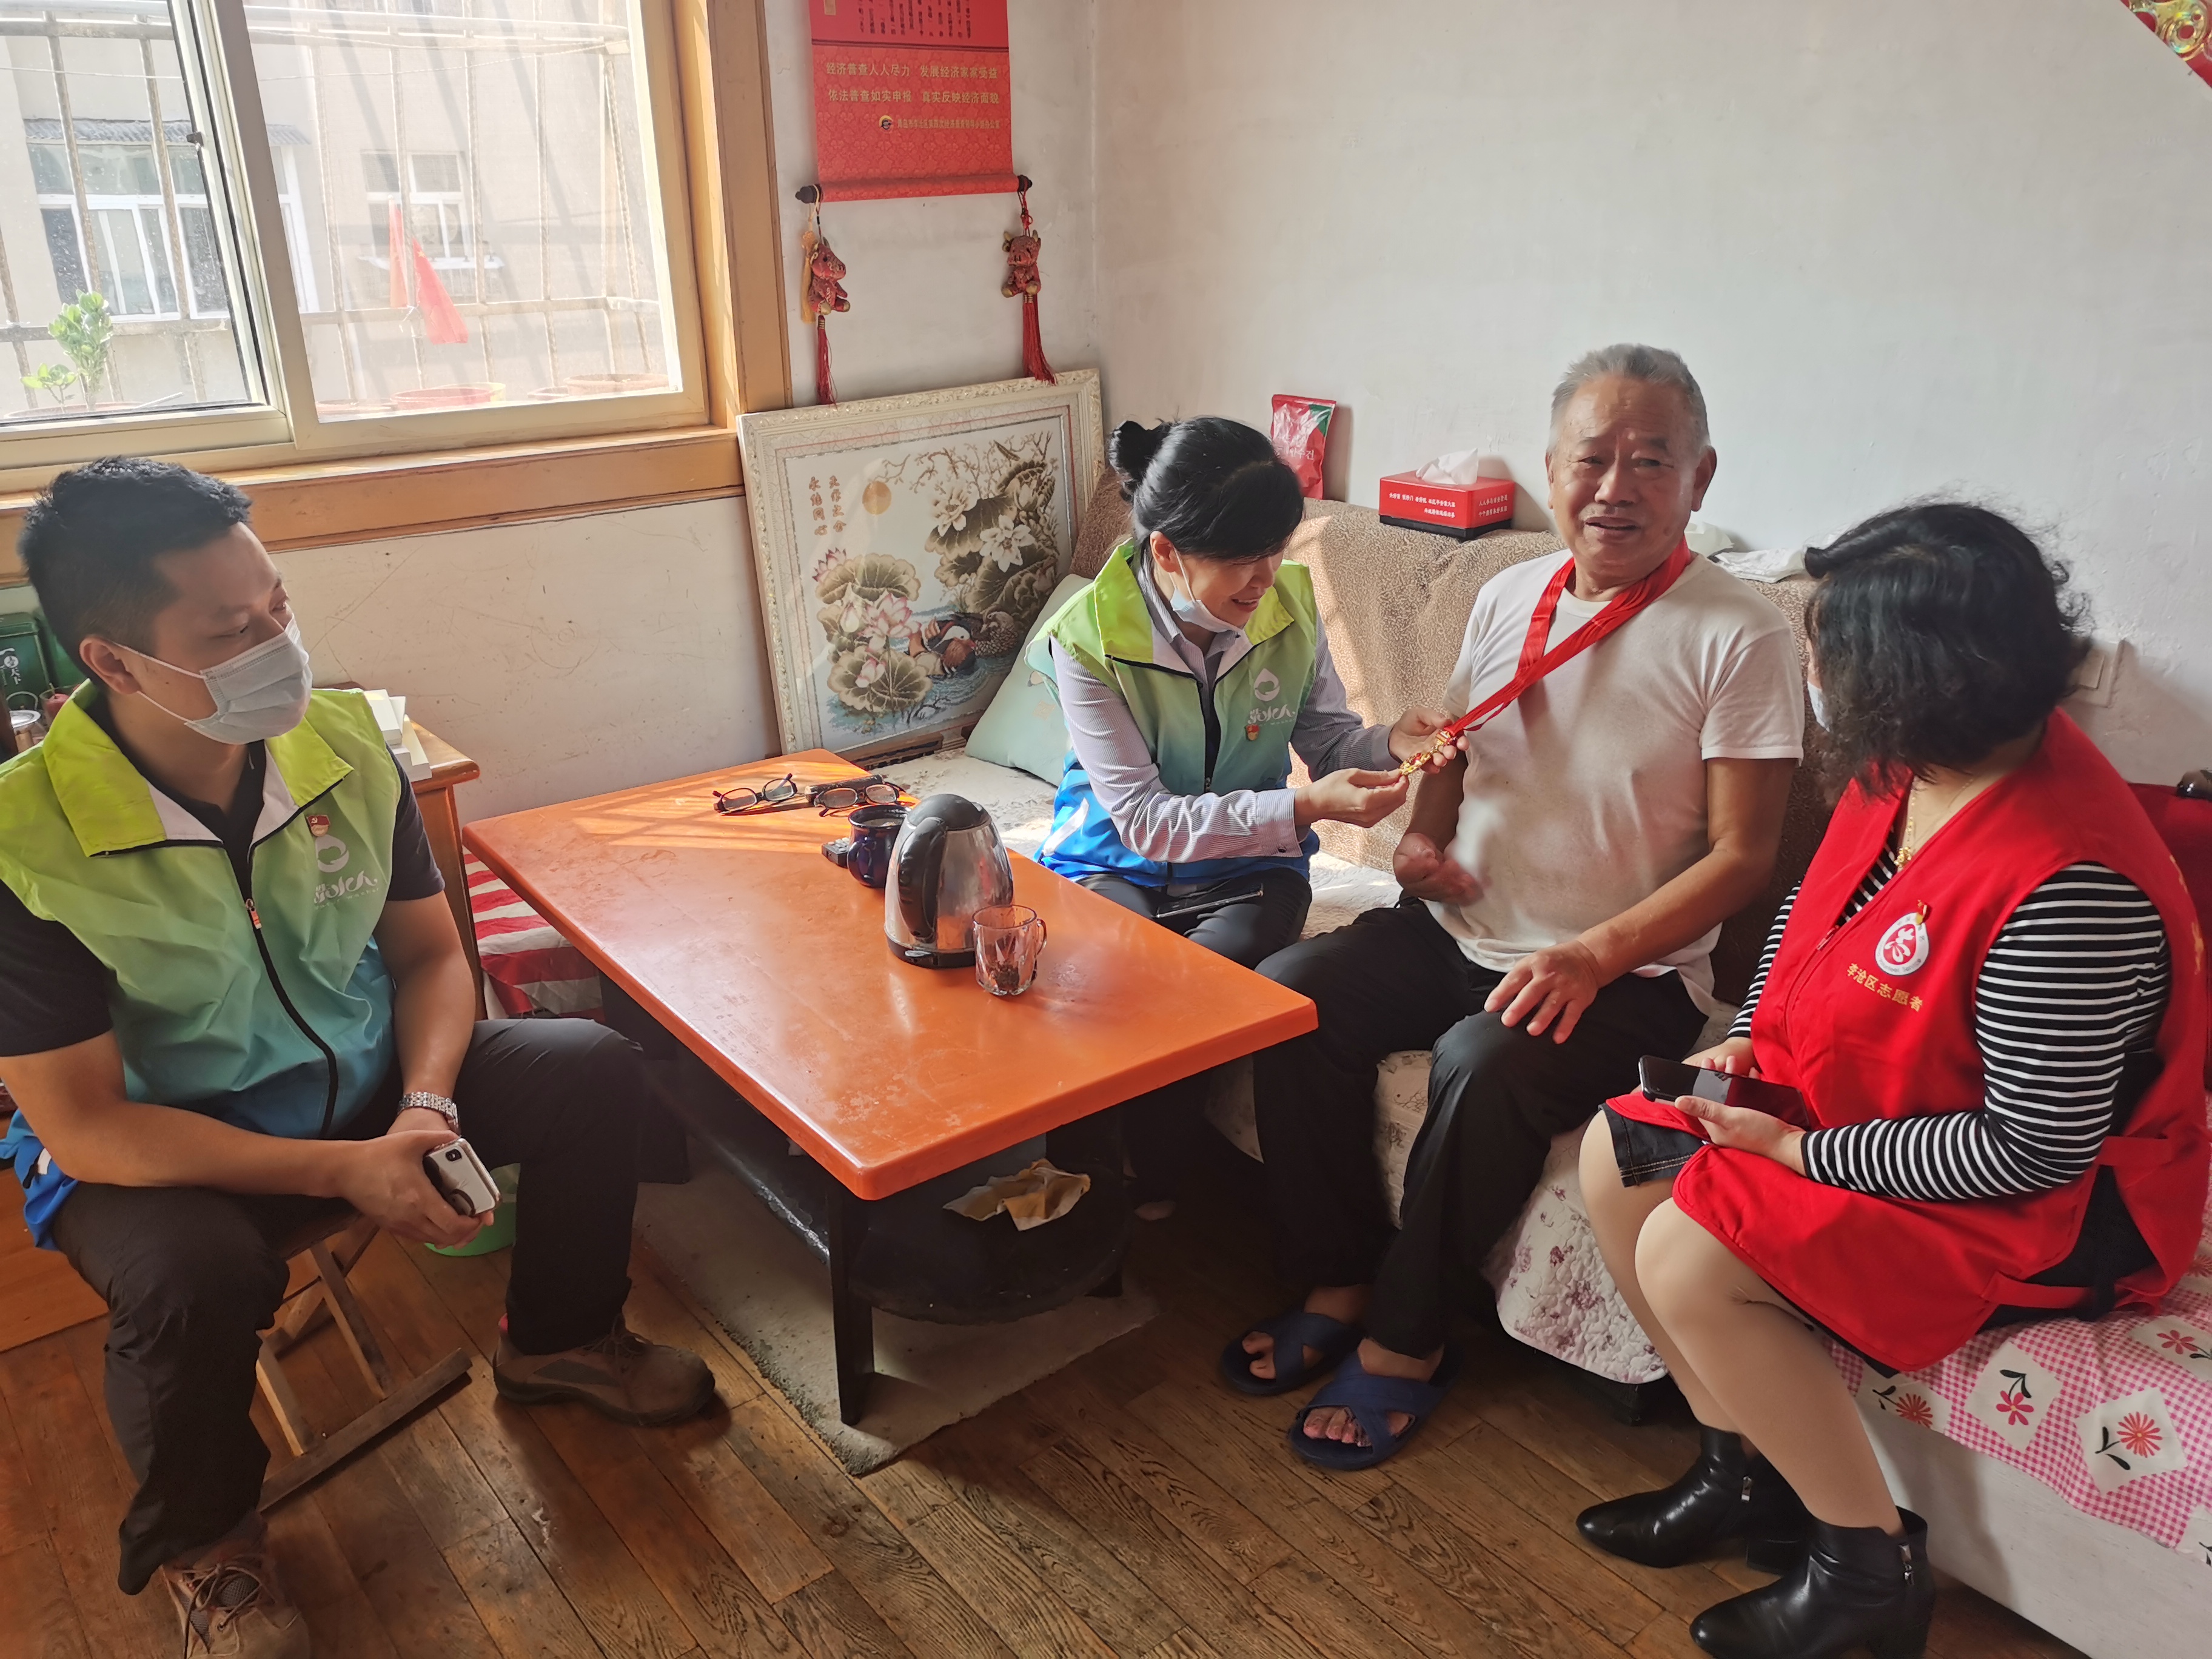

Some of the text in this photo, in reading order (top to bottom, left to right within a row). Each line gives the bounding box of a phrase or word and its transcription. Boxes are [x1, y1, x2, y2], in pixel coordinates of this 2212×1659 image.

[826, 62, 999, 80] 经济普查人人尽力 发展经济家家受益
[828, 89, 1000, 105] 依法普查如实申报 真实反映经济面貌
[1846, 963, 1924, 1013] 李沧区志愿者
